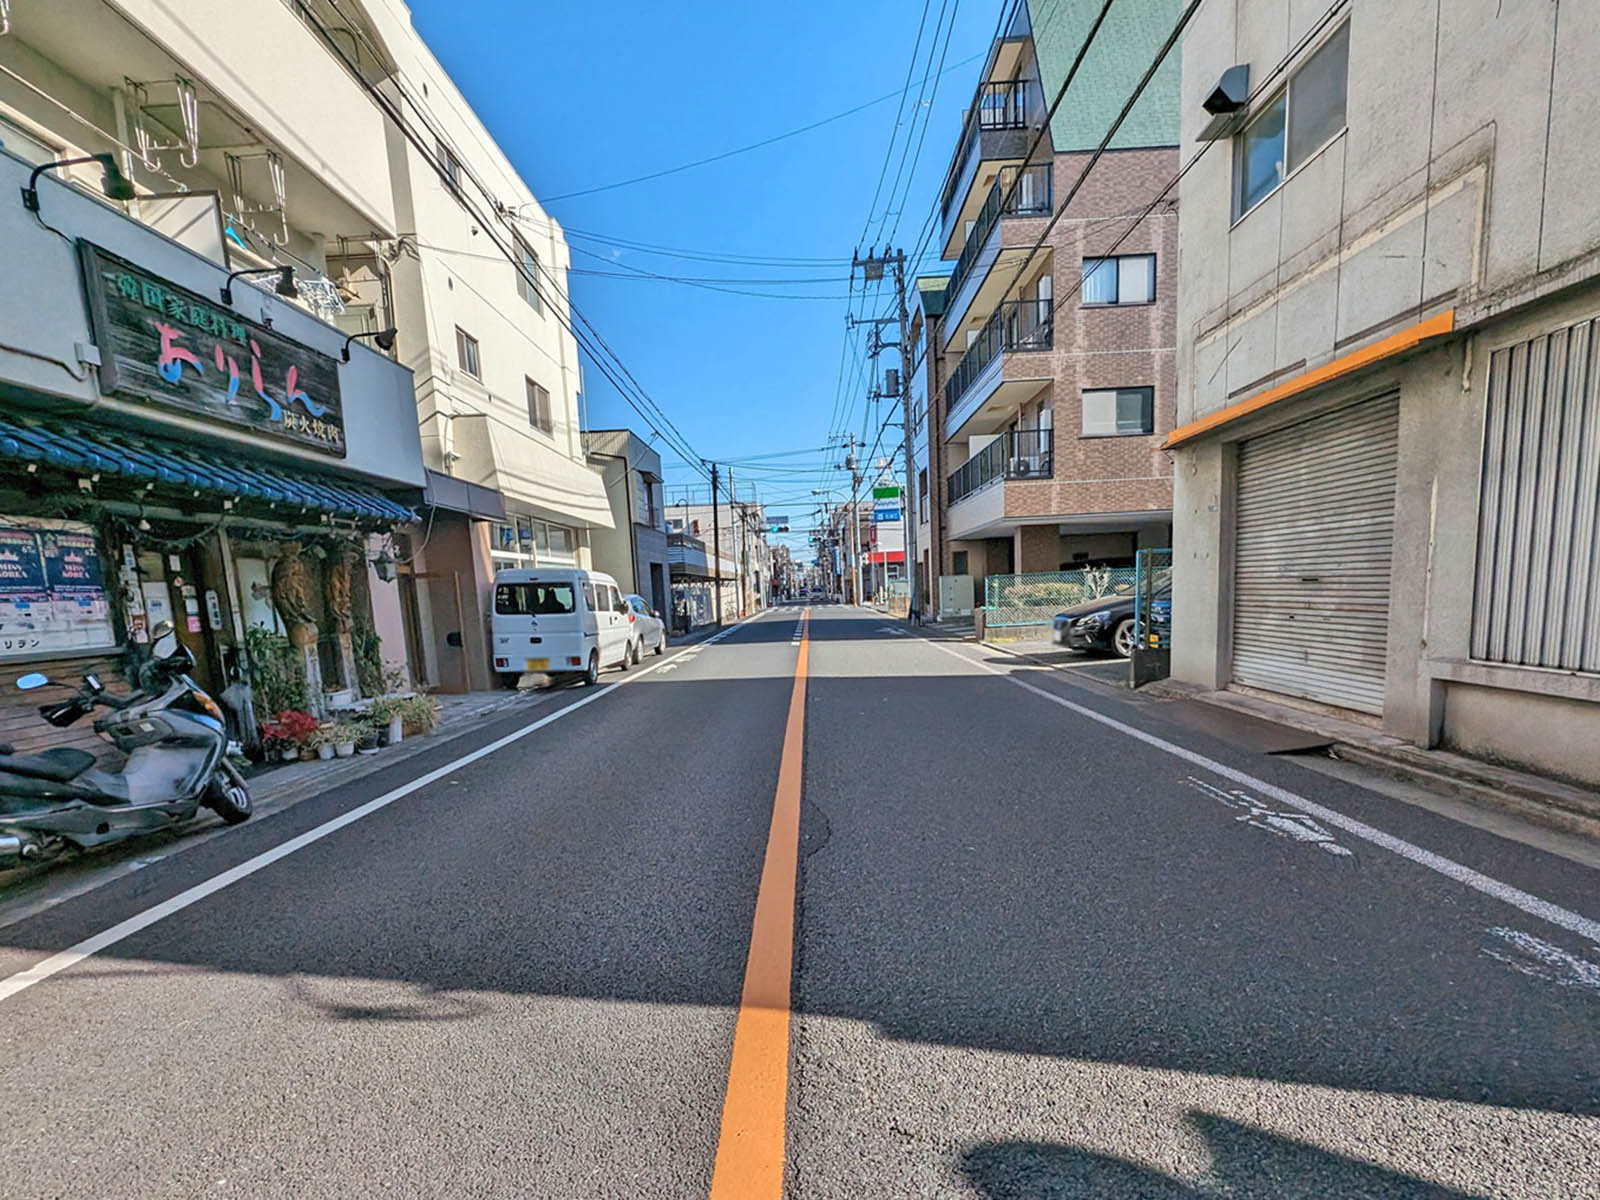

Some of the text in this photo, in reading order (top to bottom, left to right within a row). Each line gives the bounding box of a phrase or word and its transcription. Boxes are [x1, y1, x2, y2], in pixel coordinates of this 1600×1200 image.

[117, 272, 247, 346] 韓国家庭料理
[282, 409, 341, 443] 炭火焼肉
